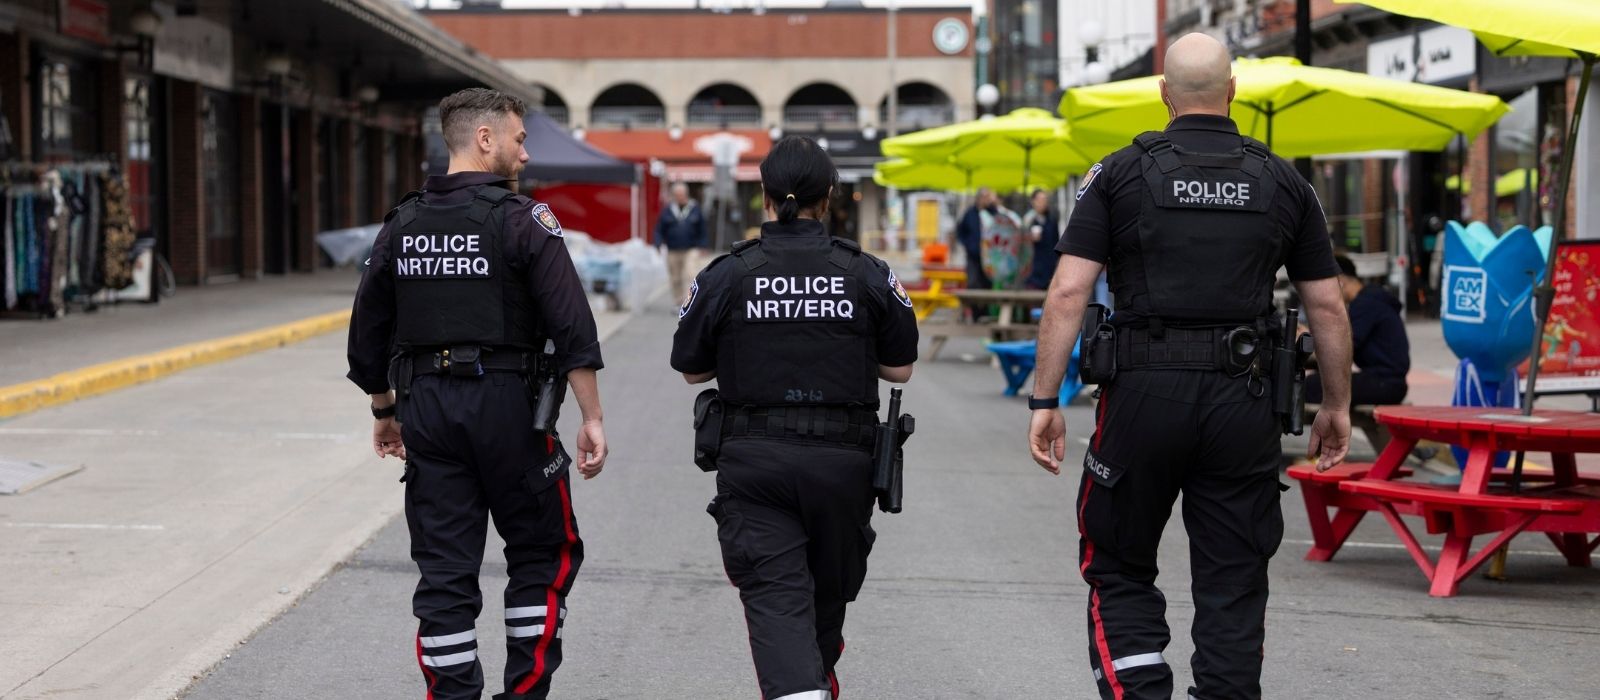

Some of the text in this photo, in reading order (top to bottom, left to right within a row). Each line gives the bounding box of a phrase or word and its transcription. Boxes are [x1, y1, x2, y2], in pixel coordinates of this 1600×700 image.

[1173, 180, 1250, 200] POLICE
[1179, 197, 1245, 206] NRT/ERQ
[402, 234, 480, 253] POLICE
[397, 257, 489, 276] NRT/ERQ
[755, 276, 845, 295] POLICE
[1454, 277, 1482, 294] AM
[747, 299, 854, 319] NRT/ERQ
[1456, 294, 1481, 311] EX
[543, 452, 564, 478] POLIC
